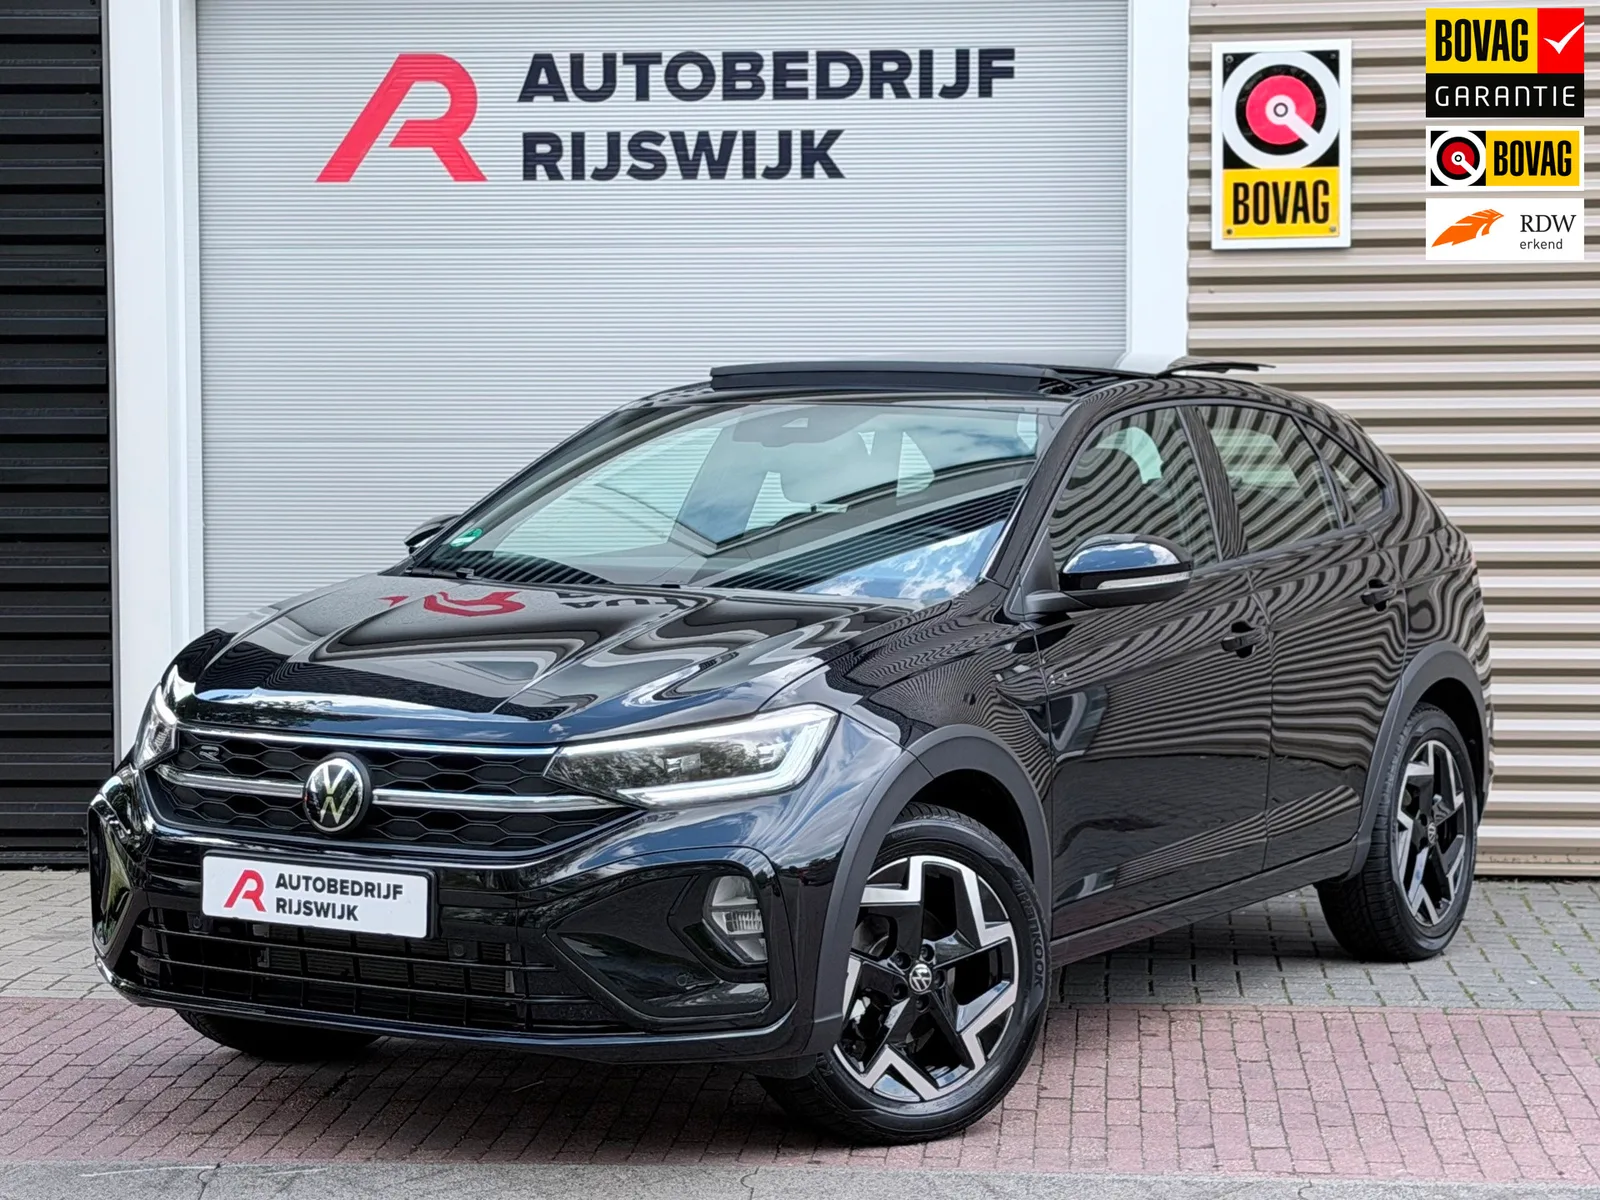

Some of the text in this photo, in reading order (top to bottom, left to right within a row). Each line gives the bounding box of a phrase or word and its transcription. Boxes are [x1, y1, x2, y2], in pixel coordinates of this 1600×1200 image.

[518, 48, 1016, 103] AUTOBEDRIJF
[522, 129, 845, 182] RIJSWIJK
[1232, 179, 1330, 226] BOVAG
[275, 872, 404, 900] AUTOBEDRIJF
[275, 897, 359, 922] RIJSWIJK
